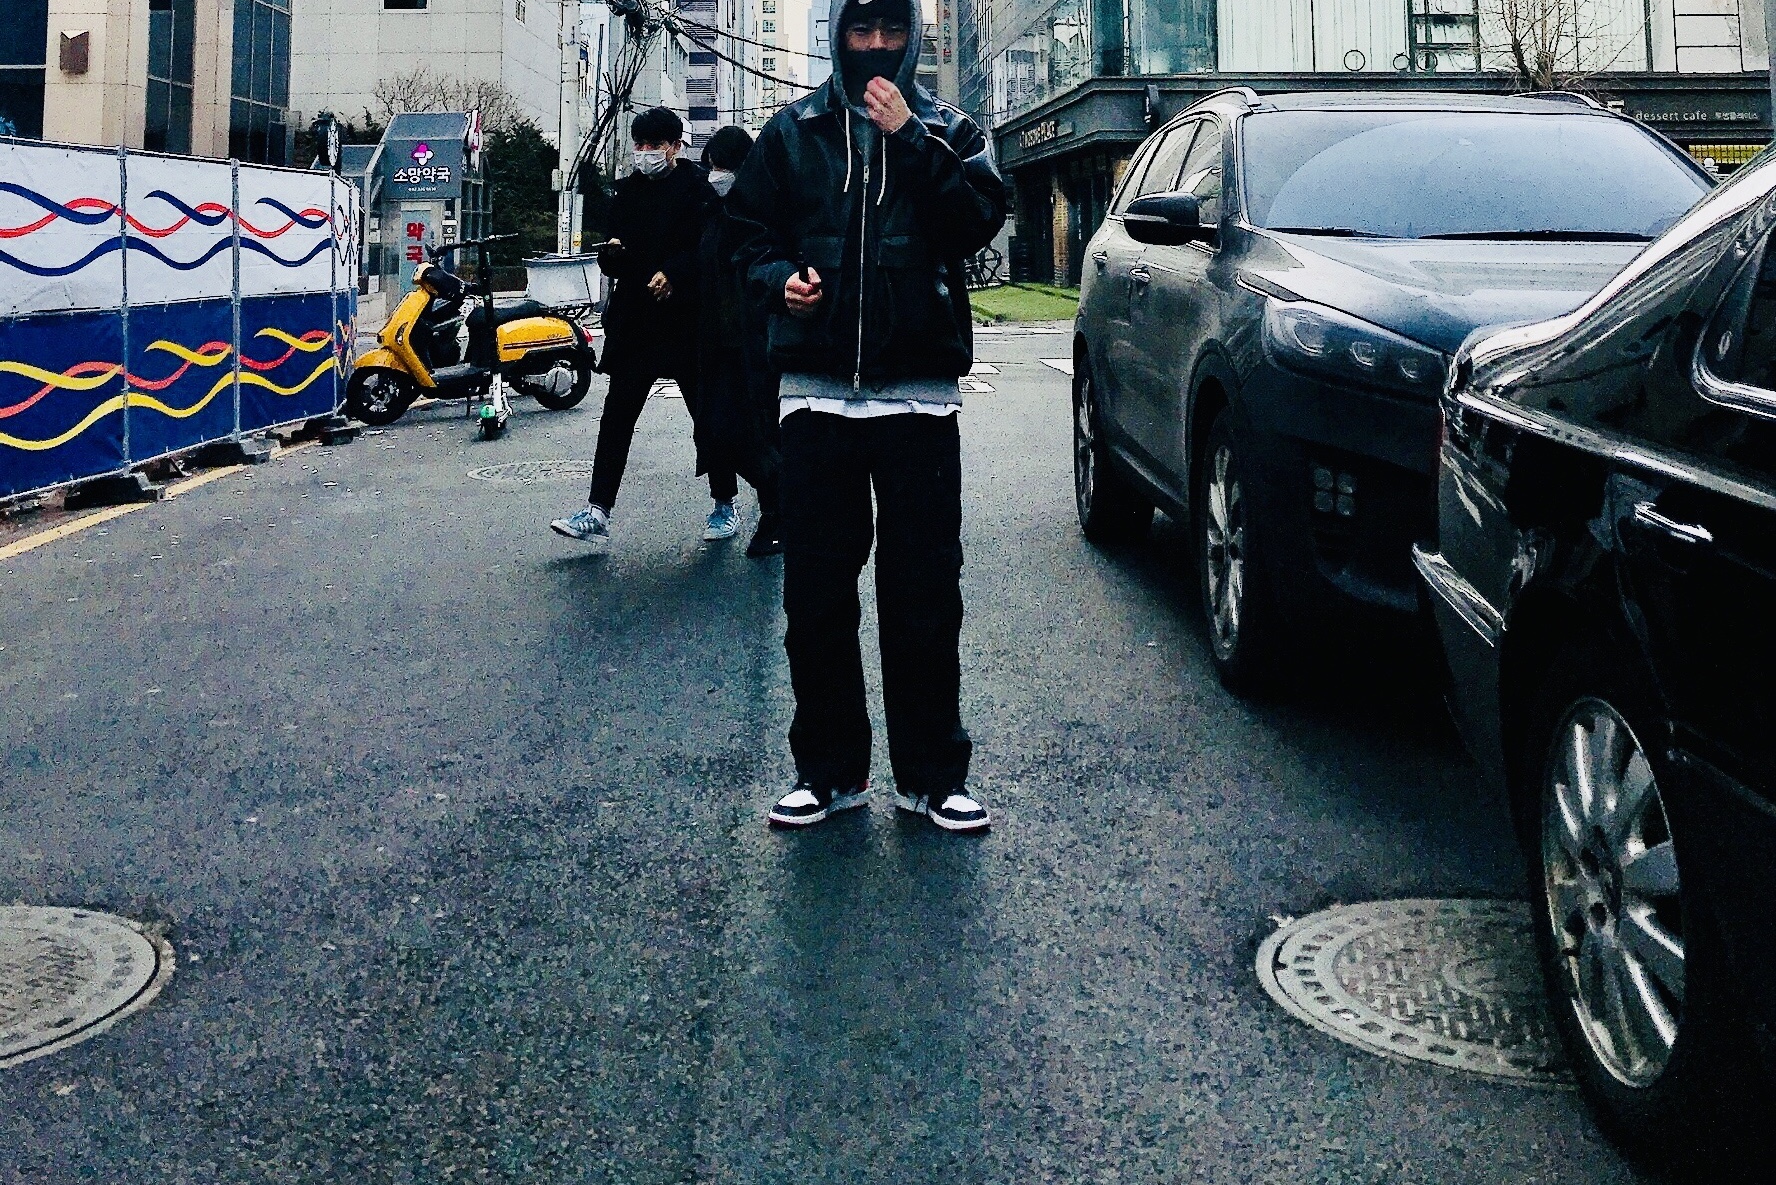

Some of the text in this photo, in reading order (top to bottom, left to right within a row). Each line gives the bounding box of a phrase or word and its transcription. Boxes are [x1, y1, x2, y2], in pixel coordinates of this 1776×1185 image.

[1635, 110, 1680, 121] dessert
[1683, 110, 1707, 121] cafe
[393, 166, 451, 184] 소망약국
